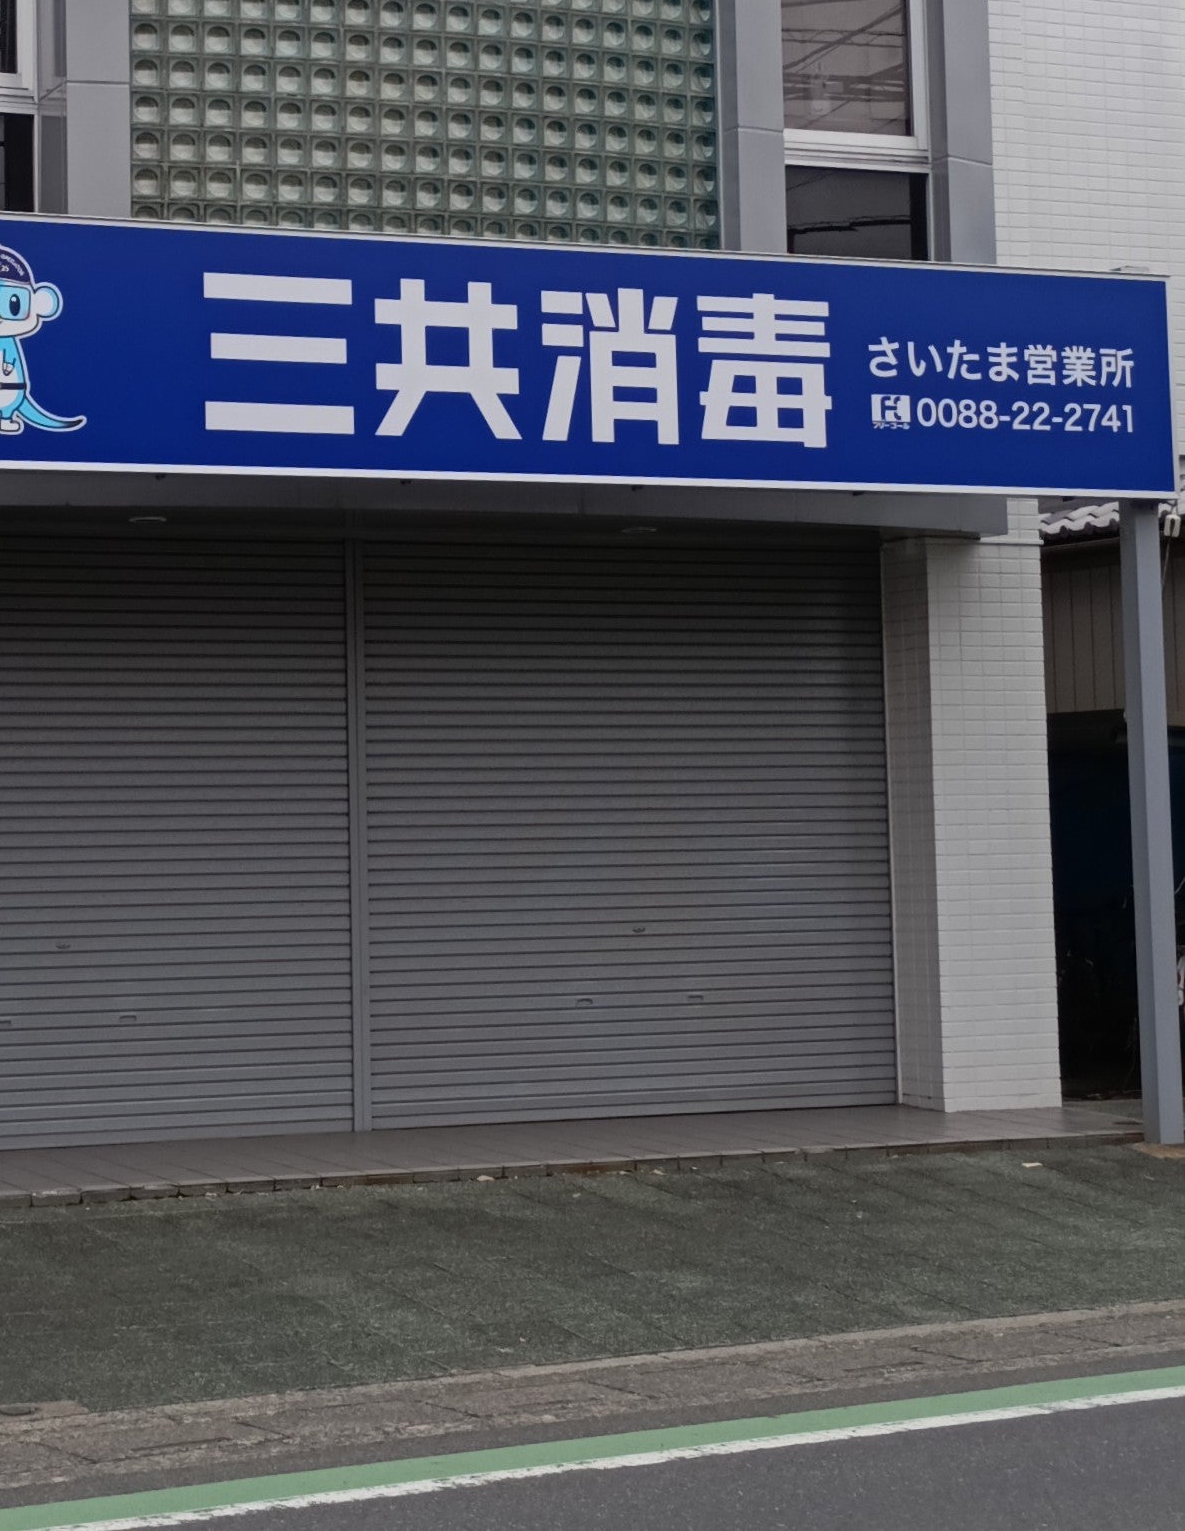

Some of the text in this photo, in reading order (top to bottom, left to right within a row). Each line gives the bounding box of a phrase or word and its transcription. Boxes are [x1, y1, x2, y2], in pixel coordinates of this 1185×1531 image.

[203, 272, 833, 448] 三共消毒
[868, 336, 1135, 388] さいたま営業所
[916, 397, 1134, 433] 0088-22-2741
